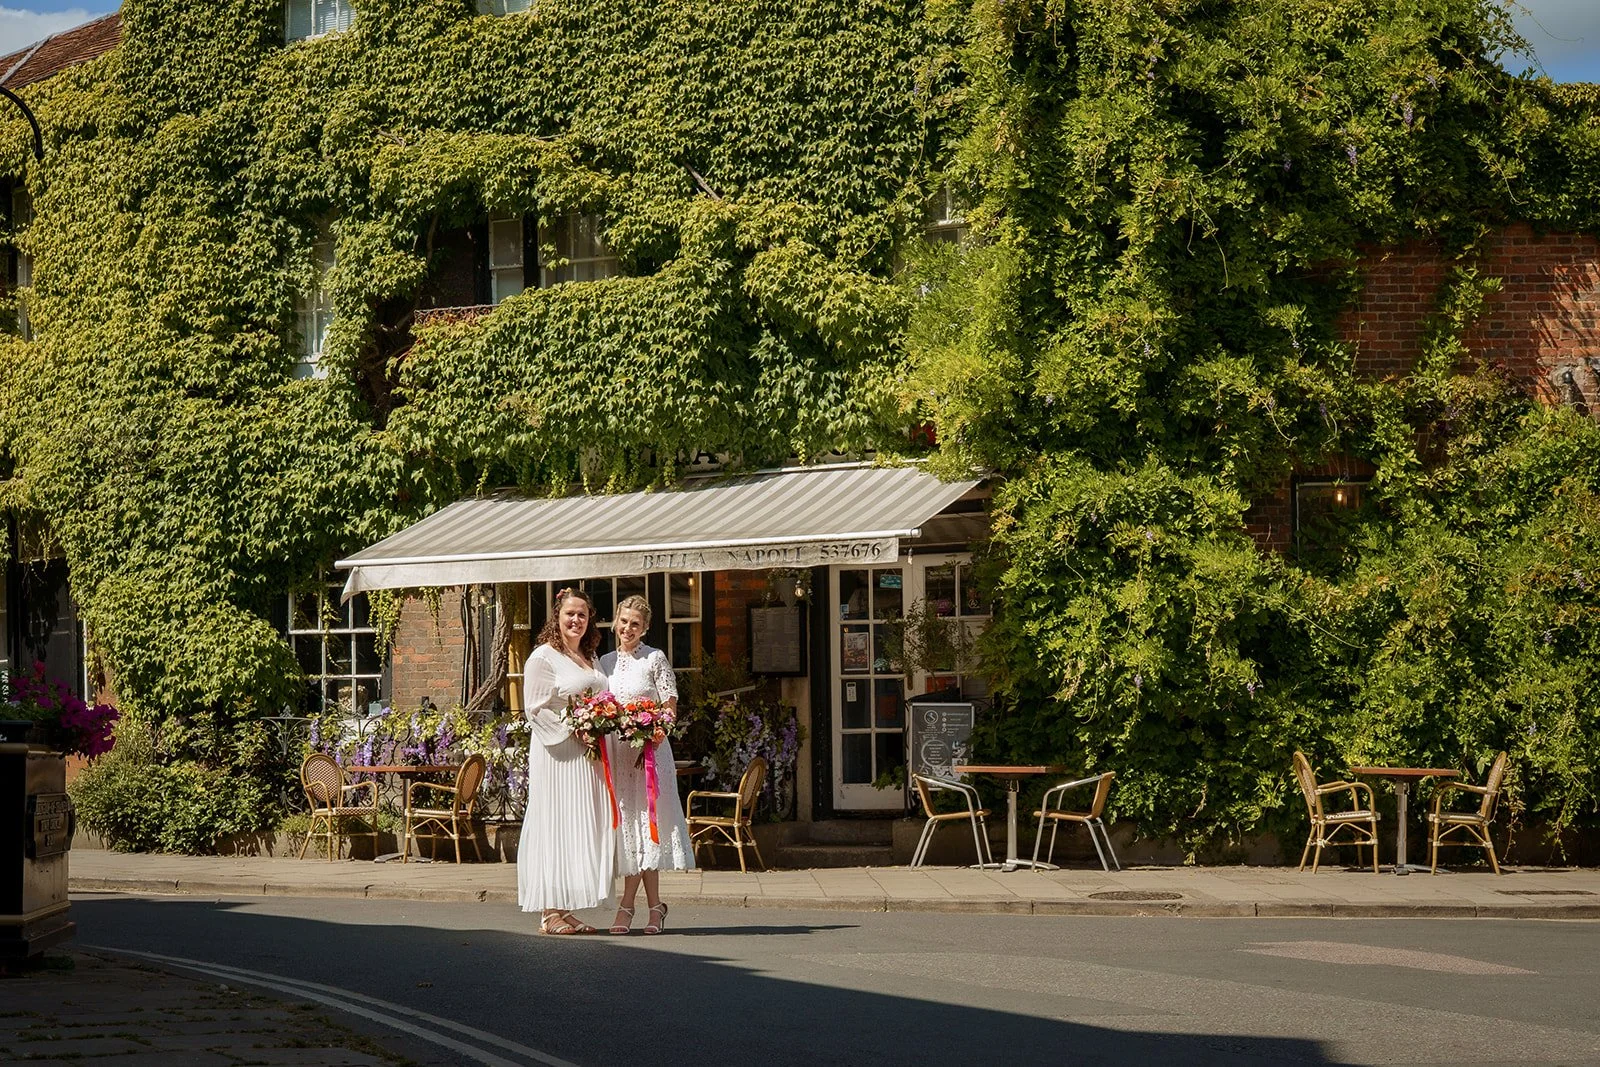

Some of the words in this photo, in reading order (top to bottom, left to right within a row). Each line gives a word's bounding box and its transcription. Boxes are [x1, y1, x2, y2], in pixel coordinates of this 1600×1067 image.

[641, 552, 706, 570] BELLA
[727, 546, 802, 566] NAPOLI
[820, 542, 881, 560] 537676
